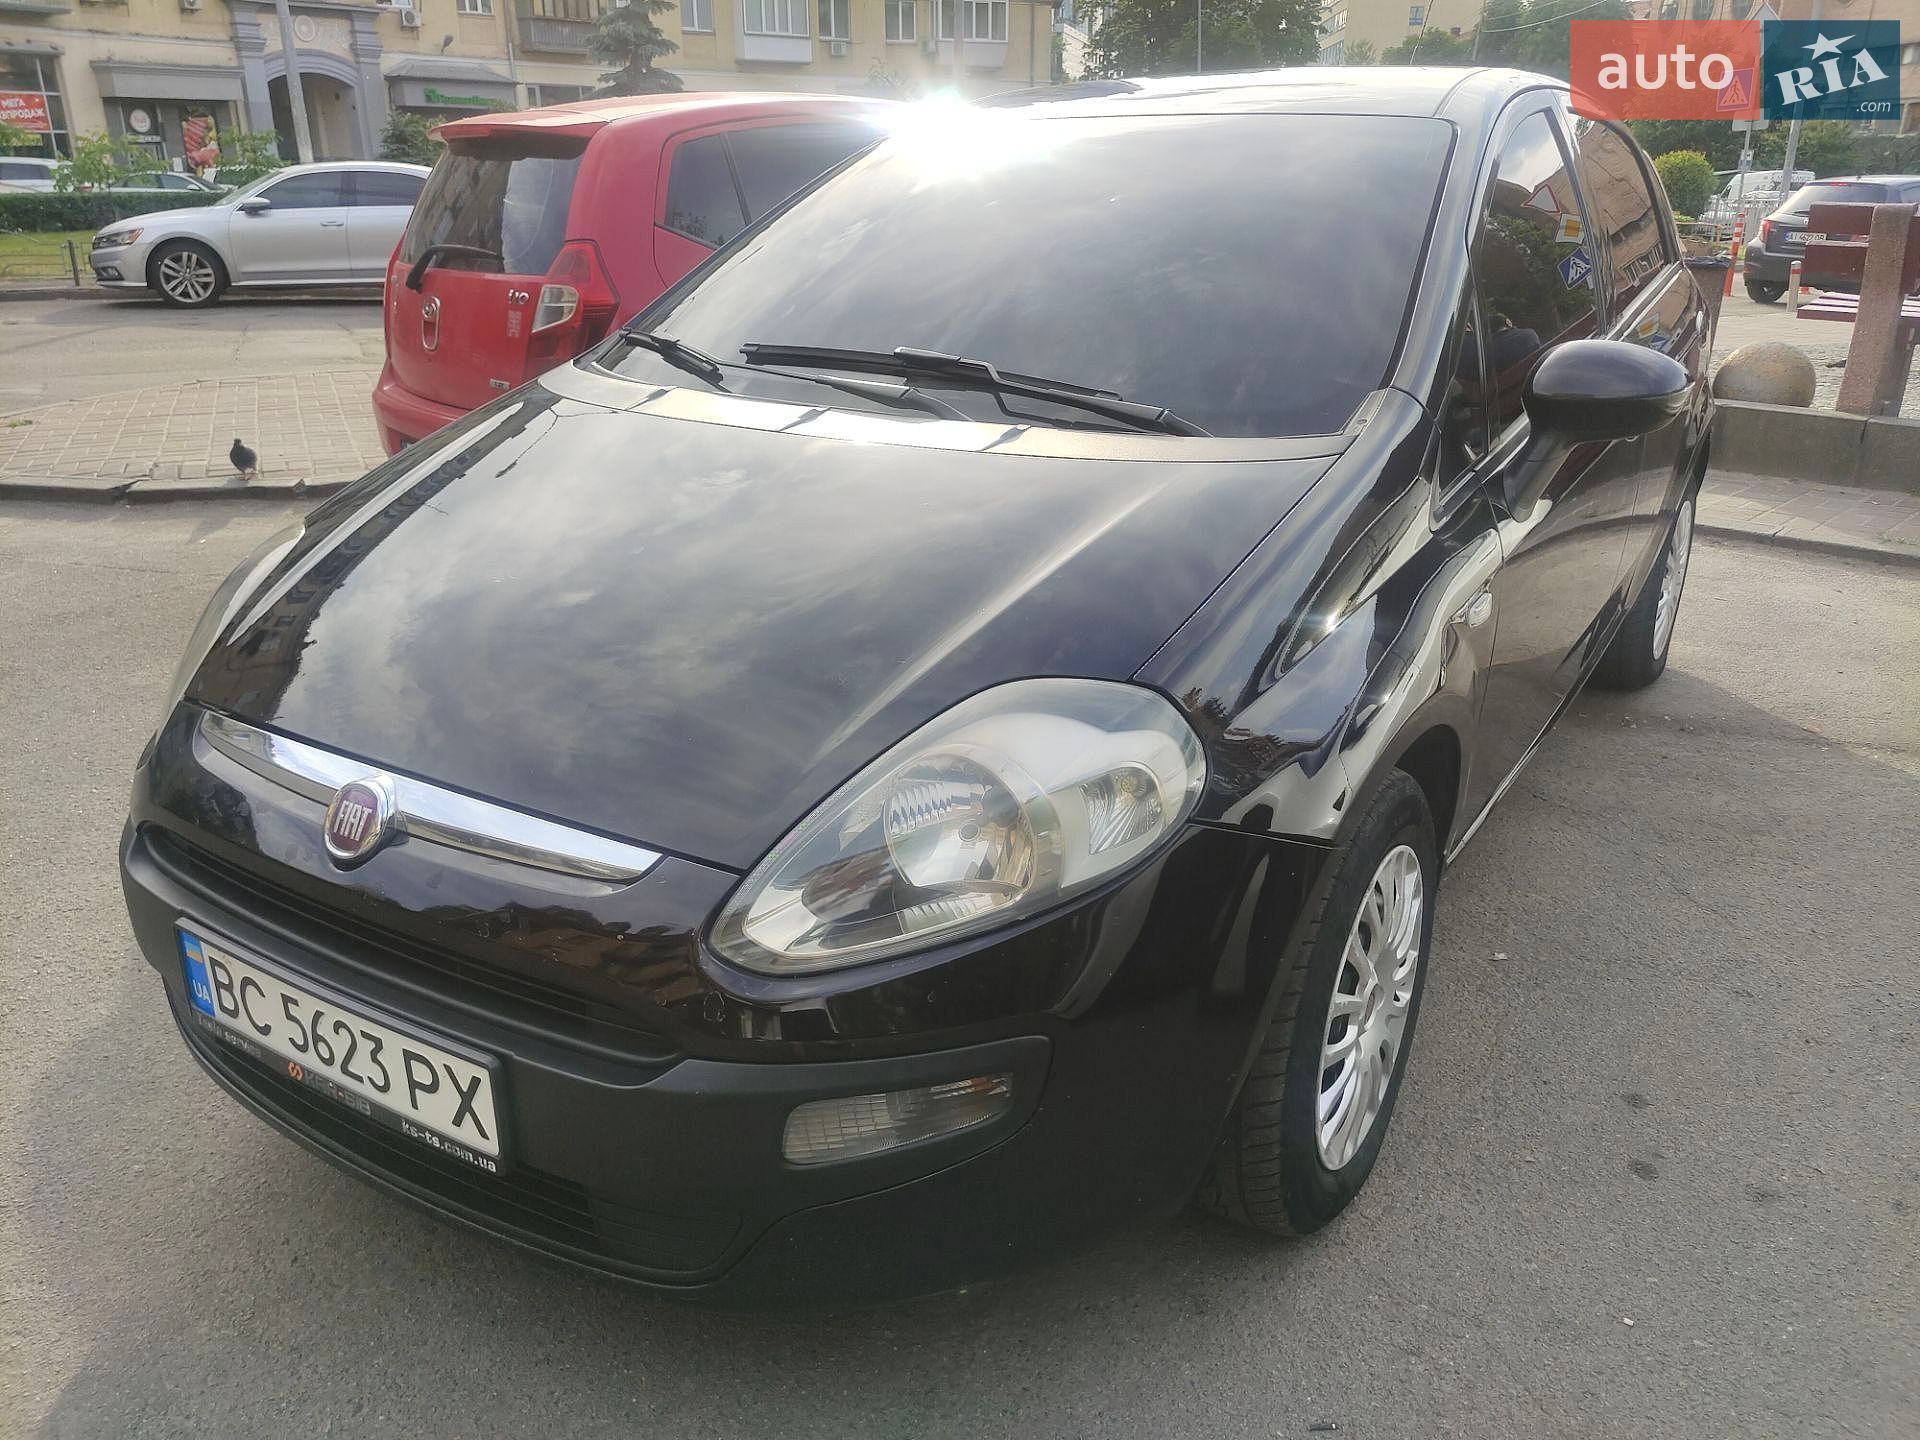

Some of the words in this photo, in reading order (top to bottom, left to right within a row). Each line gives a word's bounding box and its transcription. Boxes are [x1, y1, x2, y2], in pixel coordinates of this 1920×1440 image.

[333, 800, 373, 842] FIAT
[193, 980, 211, 1004] UA
[208, 955, 272, 1037] BC
[280, 992, 391, 1094] 5623
[402, 1048, 490, 1141] PX
